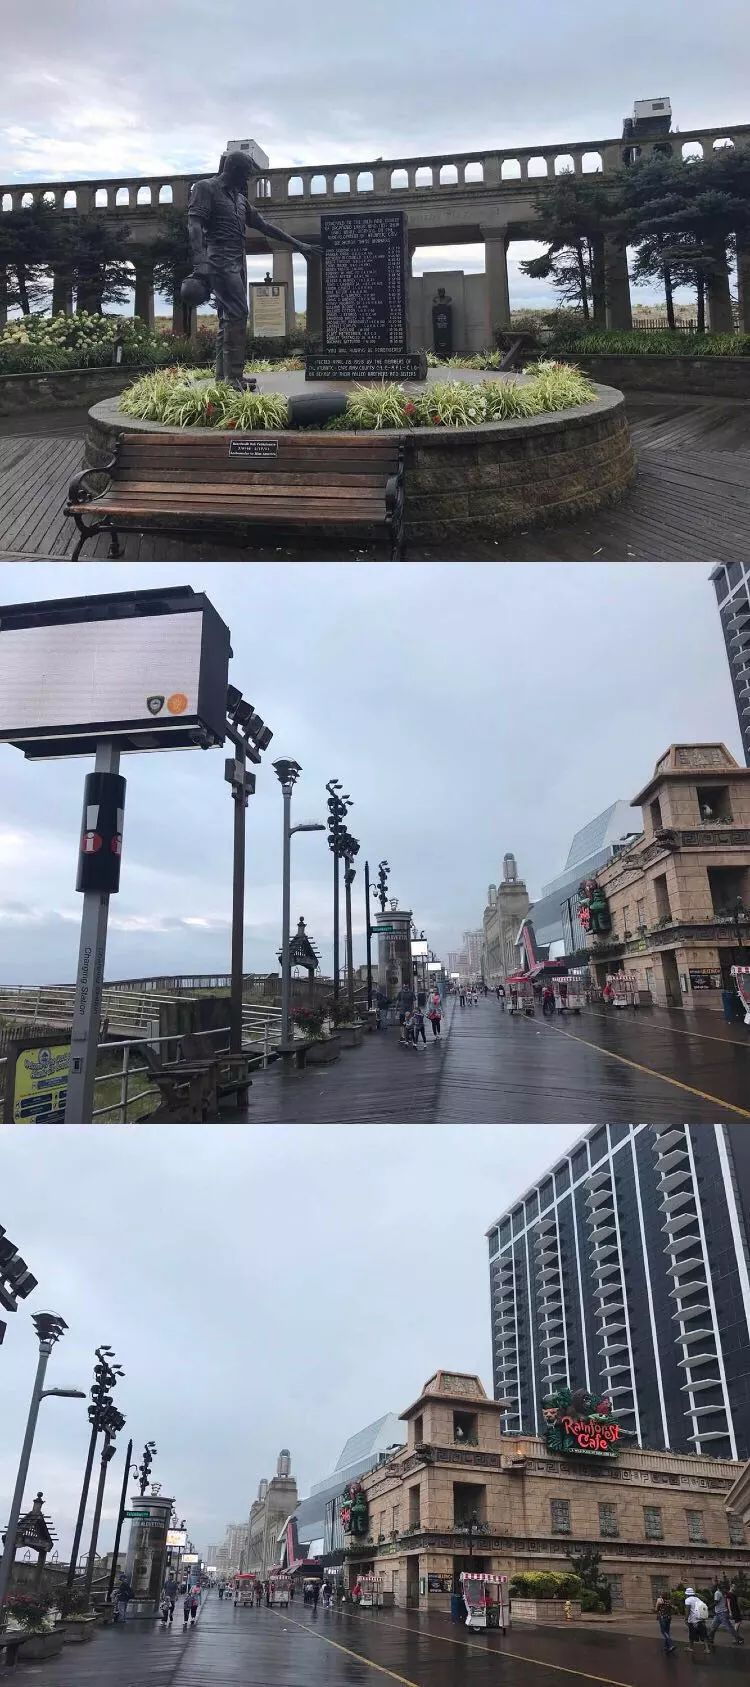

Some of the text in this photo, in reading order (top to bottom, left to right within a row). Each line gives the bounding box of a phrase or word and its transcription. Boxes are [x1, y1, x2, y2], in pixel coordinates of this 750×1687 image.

[79, 947, 92, 1016] Charging Station
[561, 1415, 621, 1443] Rainforest
[577, 1433, 608, 1451] Cafe
